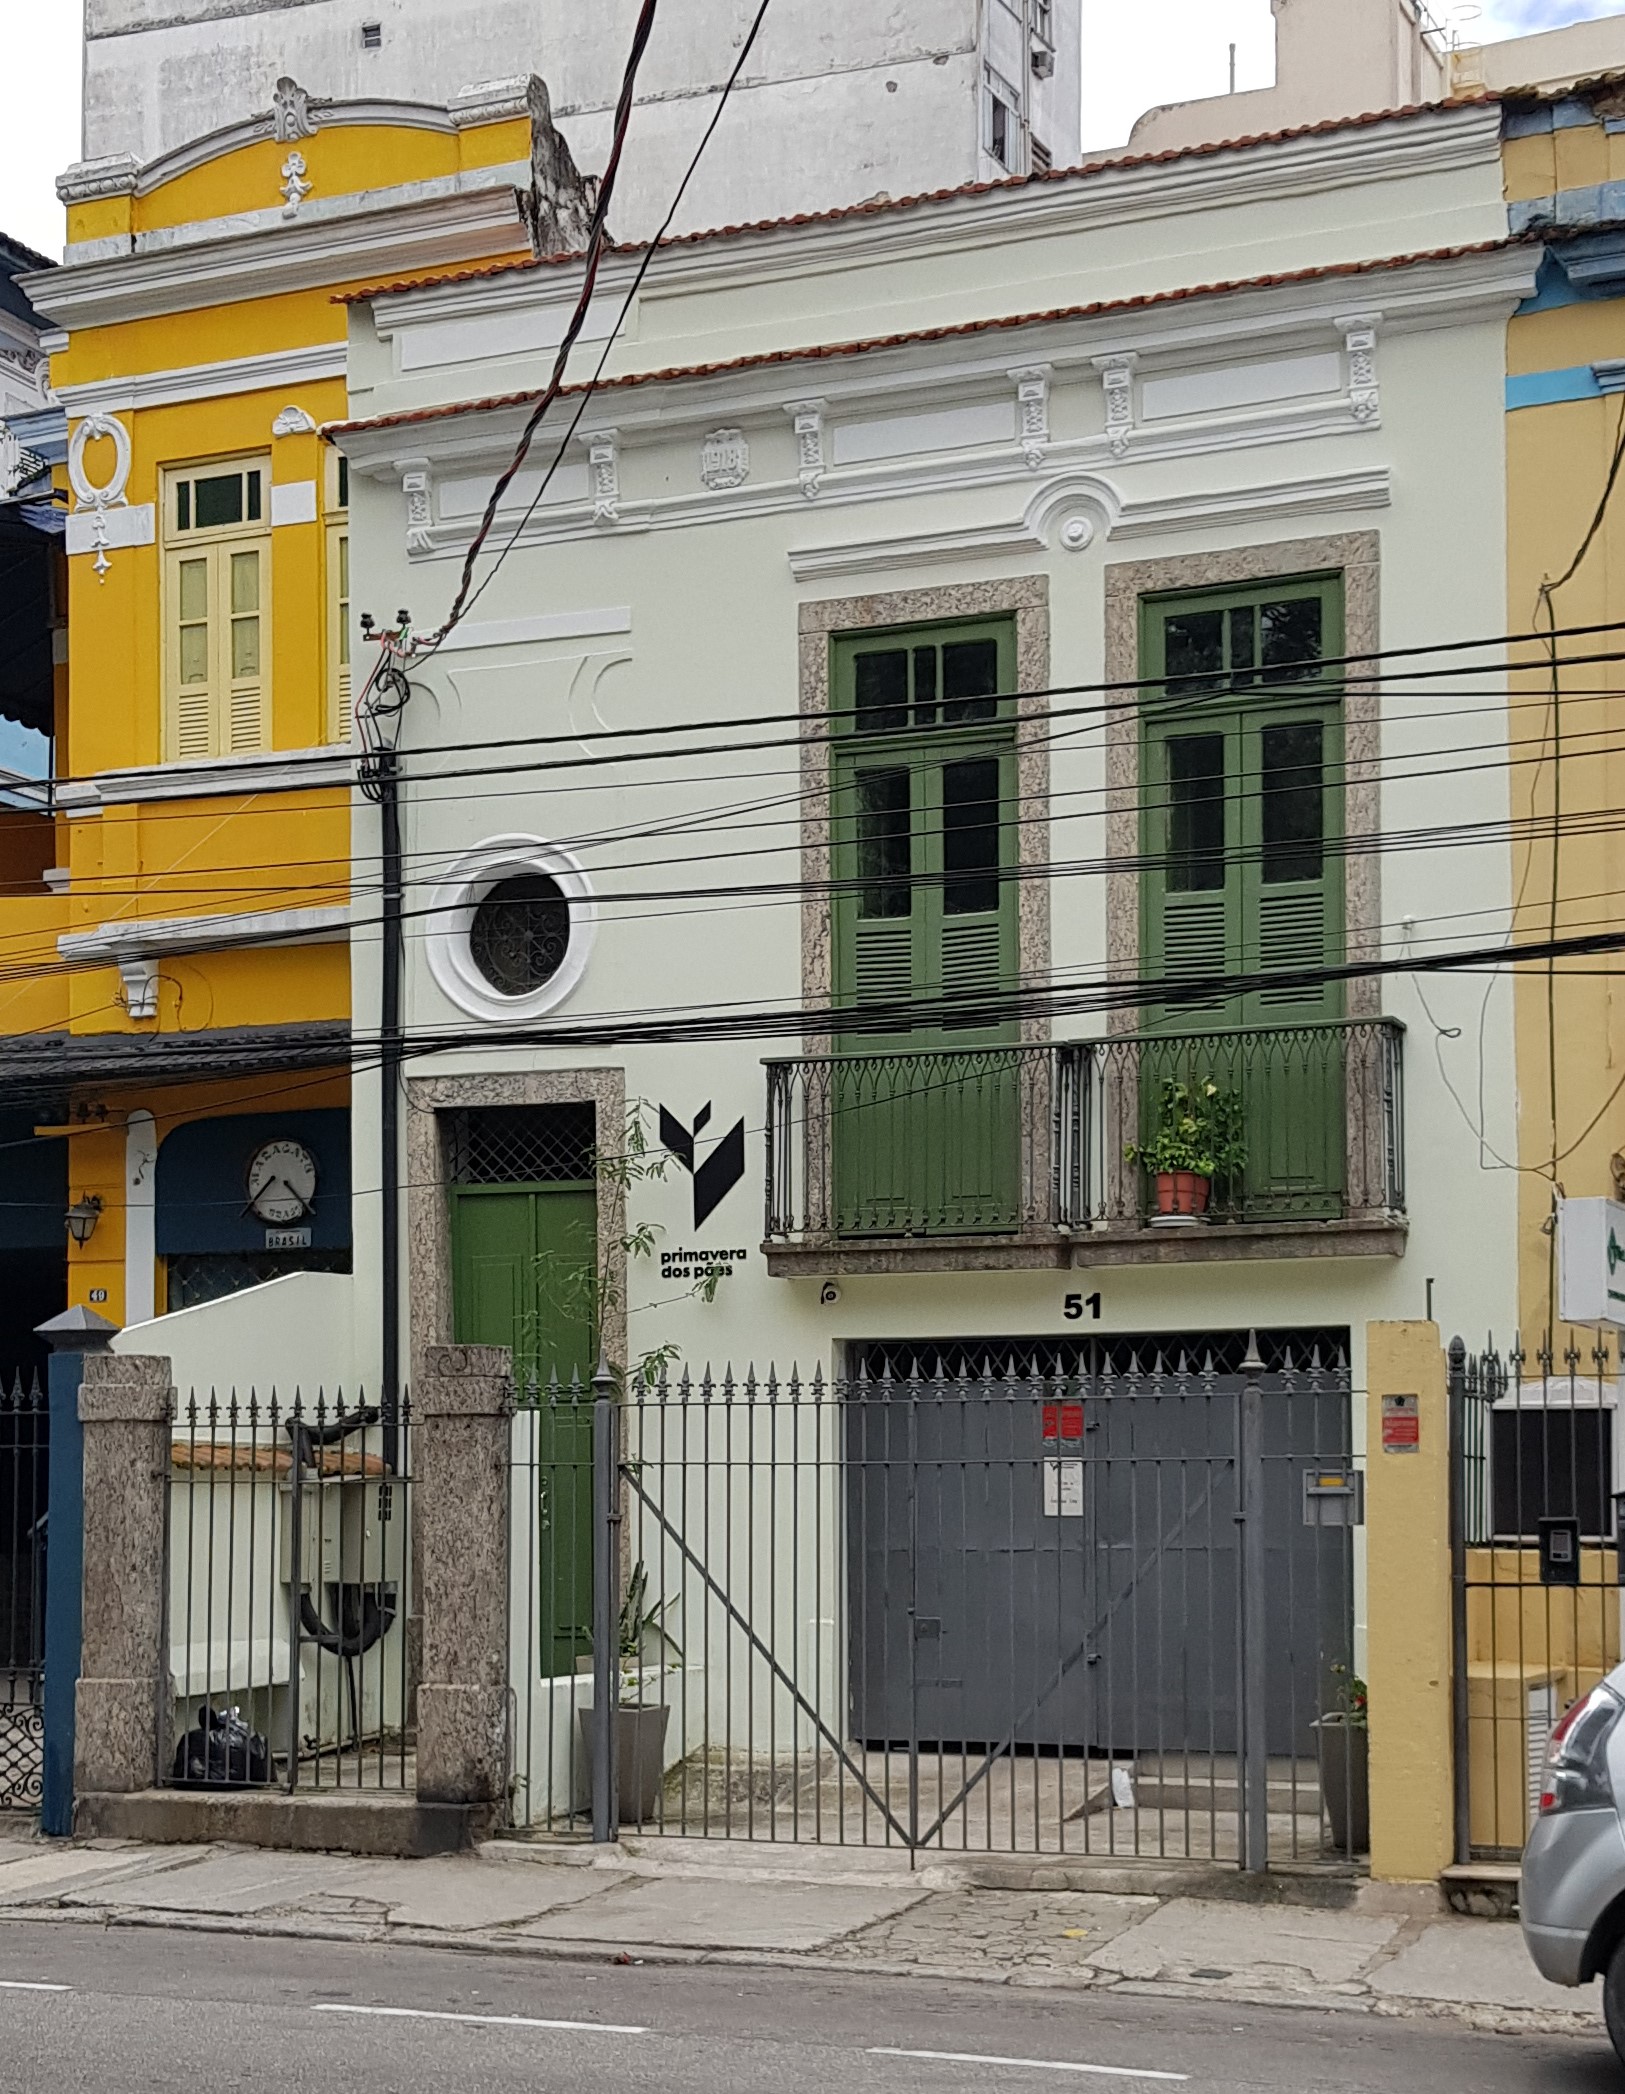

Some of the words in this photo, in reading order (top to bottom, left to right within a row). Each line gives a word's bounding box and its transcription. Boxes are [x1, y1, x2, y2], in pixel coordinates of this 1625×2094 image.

[268, 1235, 307, 1248] BRASIL
[660, 1246, 747, 1266] primavera
[661, 1265, 691, 1279] dos
[1063, 1292, 1101, 1320] 51
